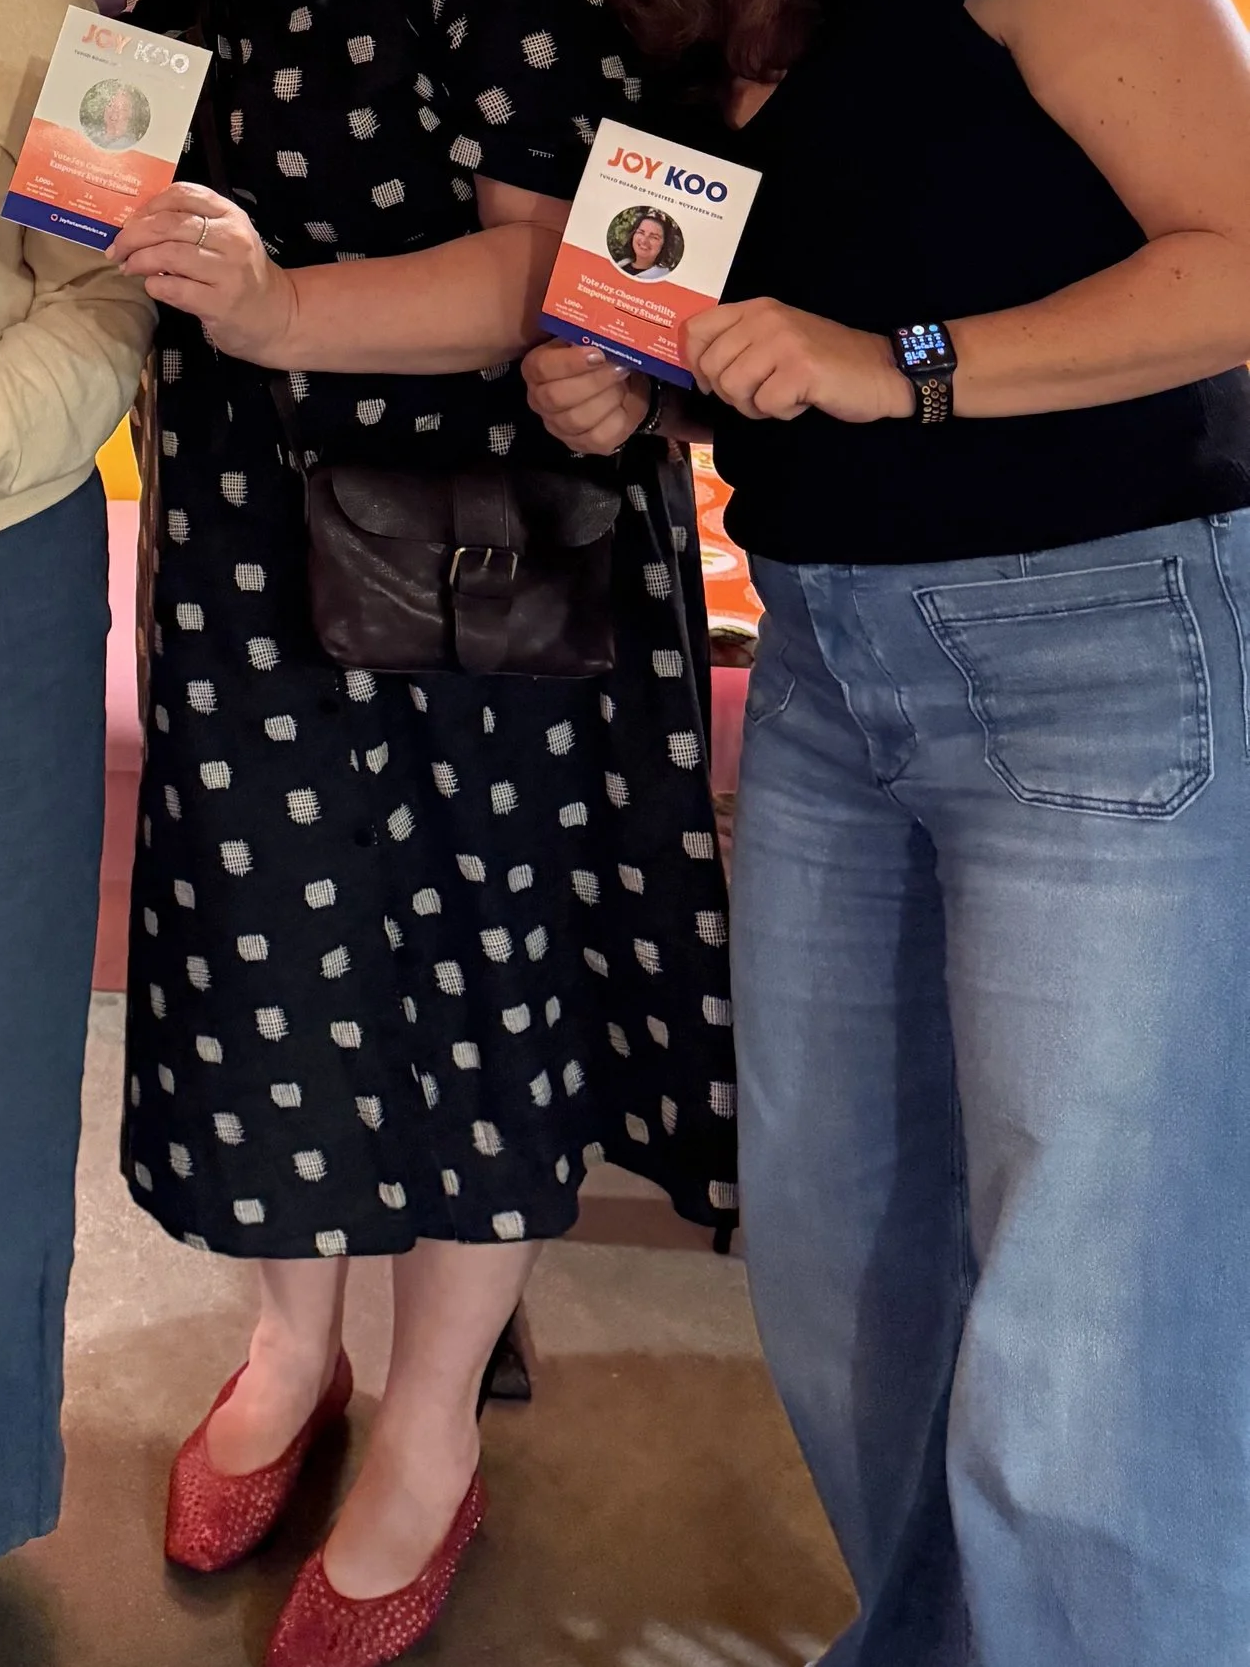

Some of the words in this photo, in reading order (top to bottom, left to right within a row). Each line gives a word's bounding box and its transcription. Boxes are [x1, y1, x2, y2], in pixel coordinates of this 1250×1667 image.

[82, 25, 130, 53] JOY
[135, 41, 189, 73] KOO
[50, 160, 85, 177] Empower
[85, 172, 108, 185] Every
[108, 180, 140, 195] Student.
[608, 148, 662, 179] JOY
[665, 167, 727, 202] KOO
[619, 180, 637, 190] BOARD
[648, 191, 674, 203] TRUSTEES
[679, 202, 709, 215] NOVEMBER
[577, 284, 616, 304] Empower
[614, 299, 639, 314] Every
[639, 309, 673, 327] Student.
[581, 274, 599, 287] Vote
[599, 282, 615, 294] Joy.
[615, 289, 644, 305] Choose
[645, 301, 676, 318] Civility.
